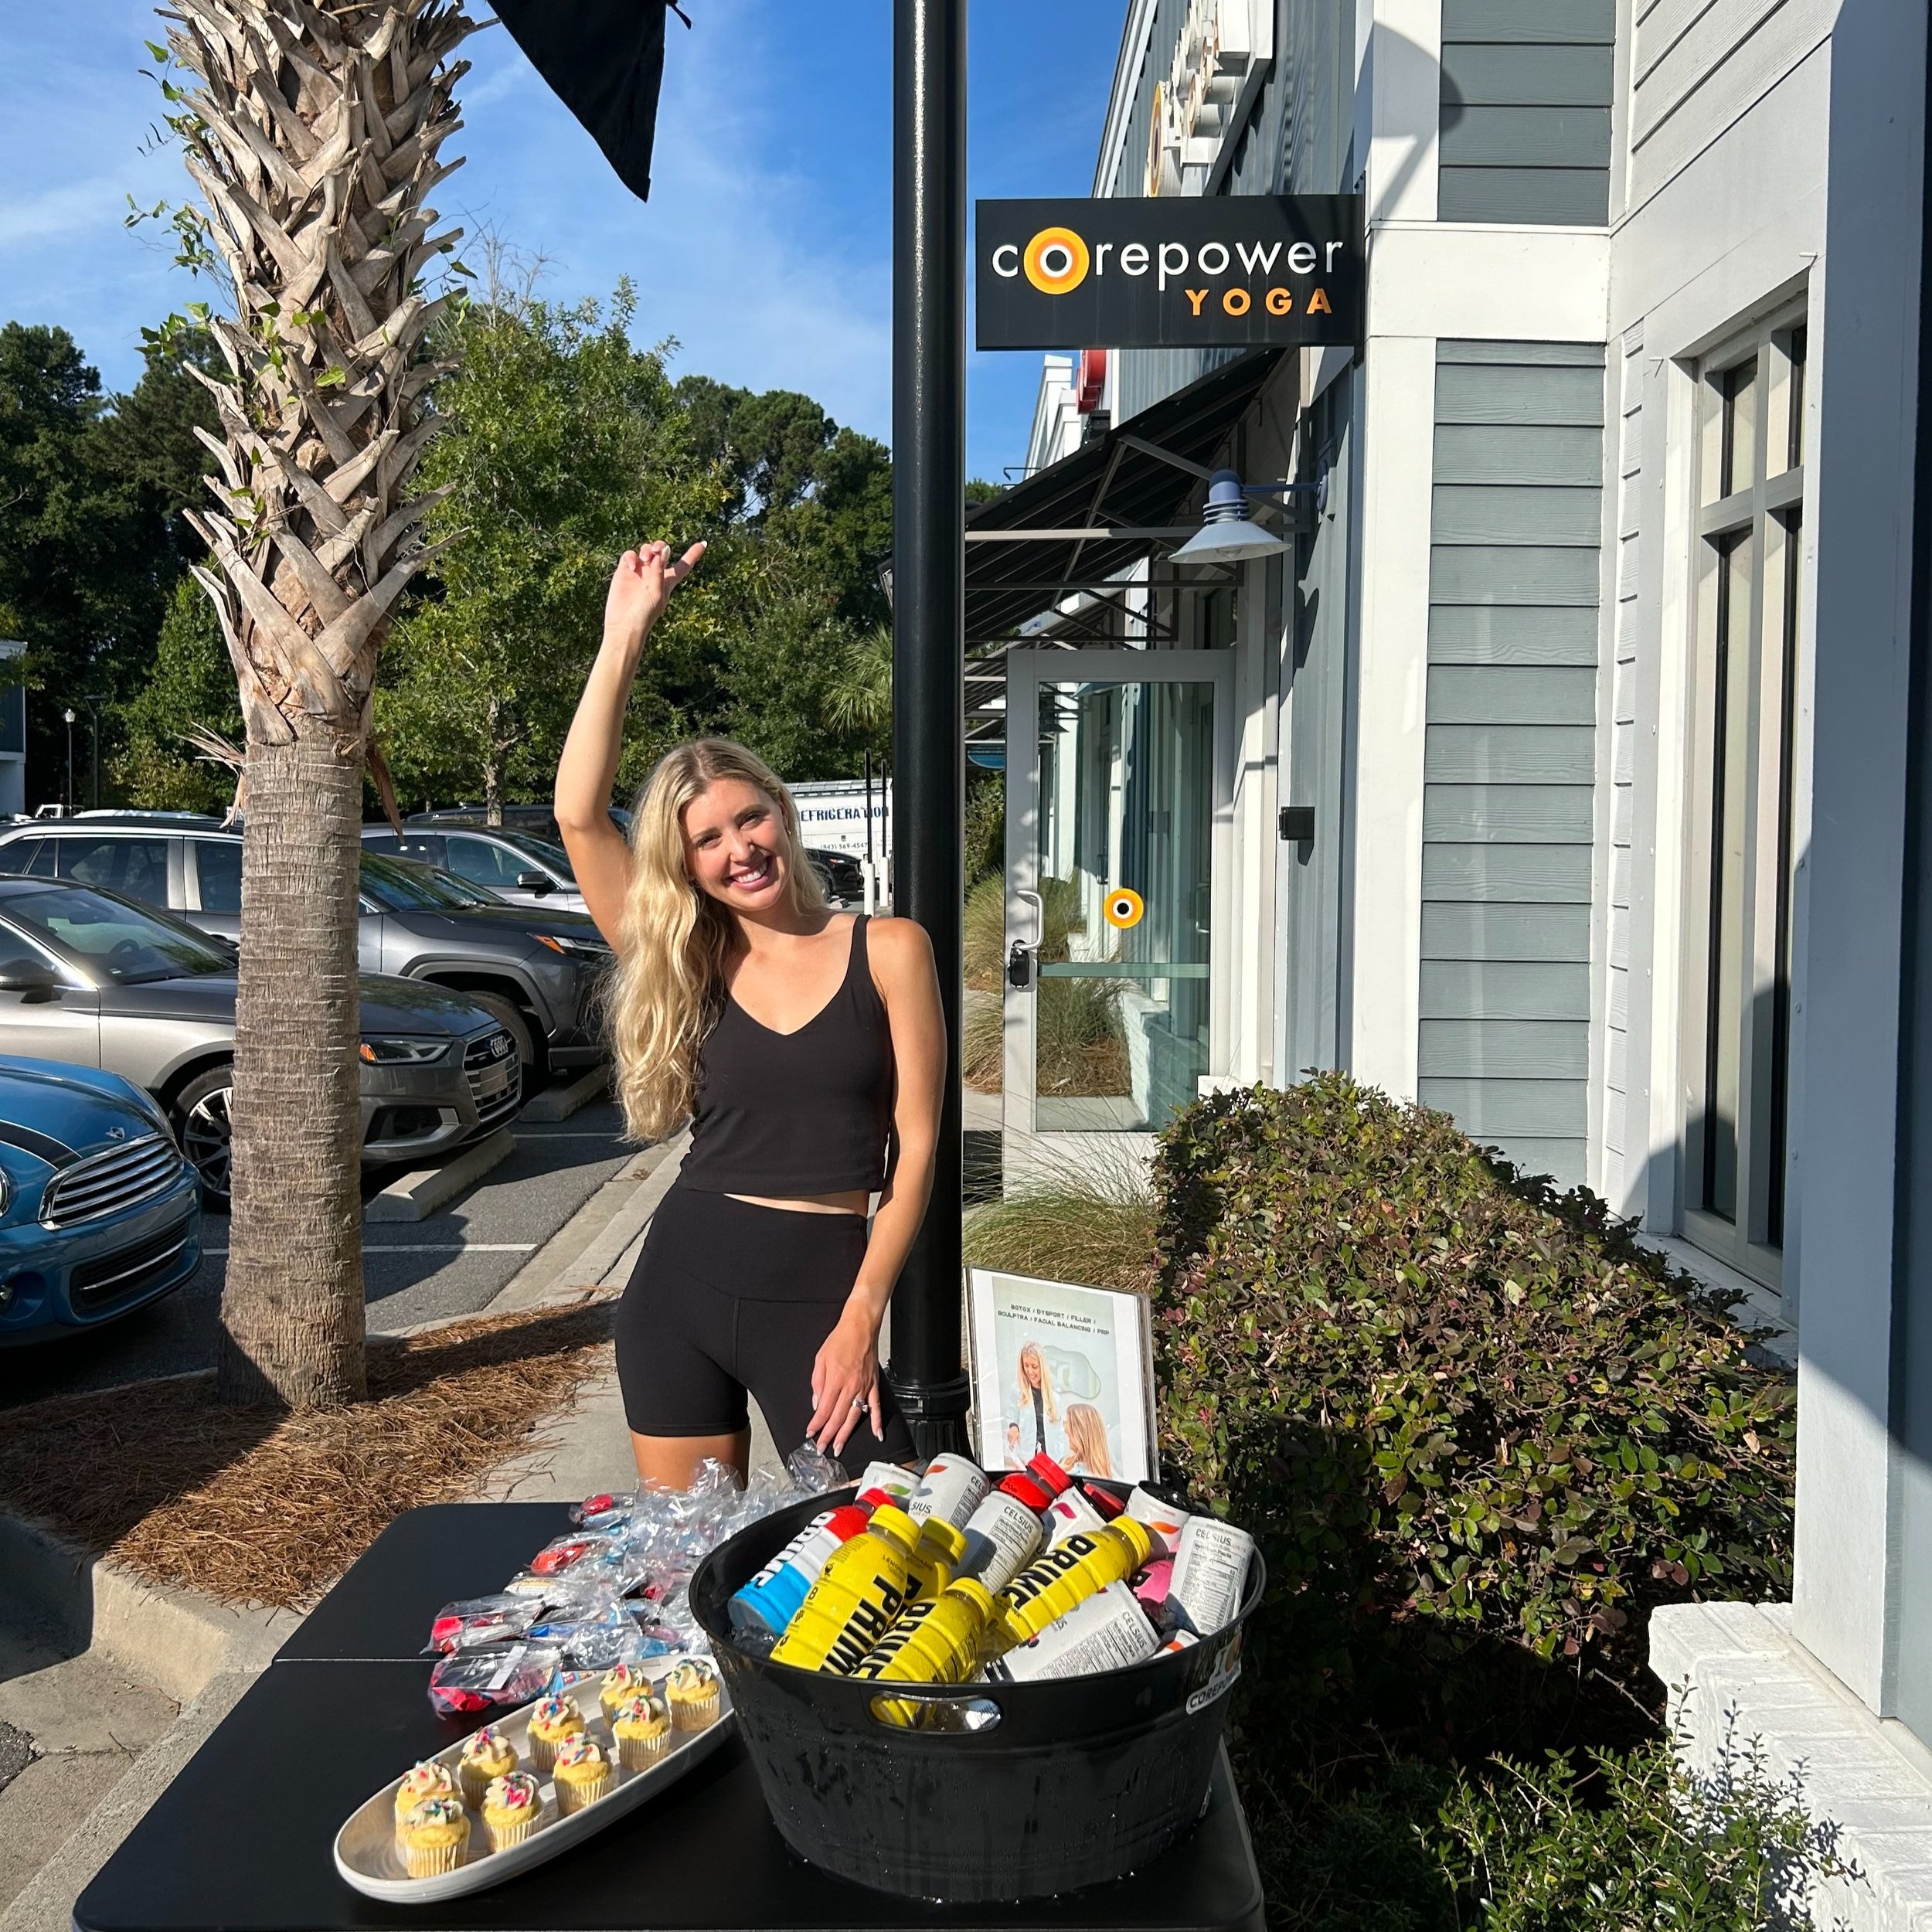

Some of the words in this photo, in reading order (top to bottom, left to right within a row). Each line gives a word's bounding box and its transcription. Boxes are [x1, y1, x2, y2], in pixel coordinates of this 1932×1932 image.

[992, 240, 1344, 292] corepower
[1184, 287, 1332, 316] YOGA
[801, 806, 889, 821] EFRIGERATION
[997, 1310, 1029, 1321] SCULPTRA
[1033, 1317, 1056, 1326] FACIAL
[1011, 1304, 1031, 1313] BOTOX
[1036, 1308, 1065, 1319] DYSPORT
[1070, 1315, 1092, 1324] FILLER
[971, 1475, 986, 1492] CELS
[912, 1502, 933, 1515] SIUS
[1004, 1505, 1034, 1534] CELSIUS
[1196, 1528, 1232, 1546] CELSIUS
[1002, 1534, 1097, 1611] PRIME
[818, 1573, 904, 1675] PRIM
[1121, 1611, 1148, 1649] CELSIUS
